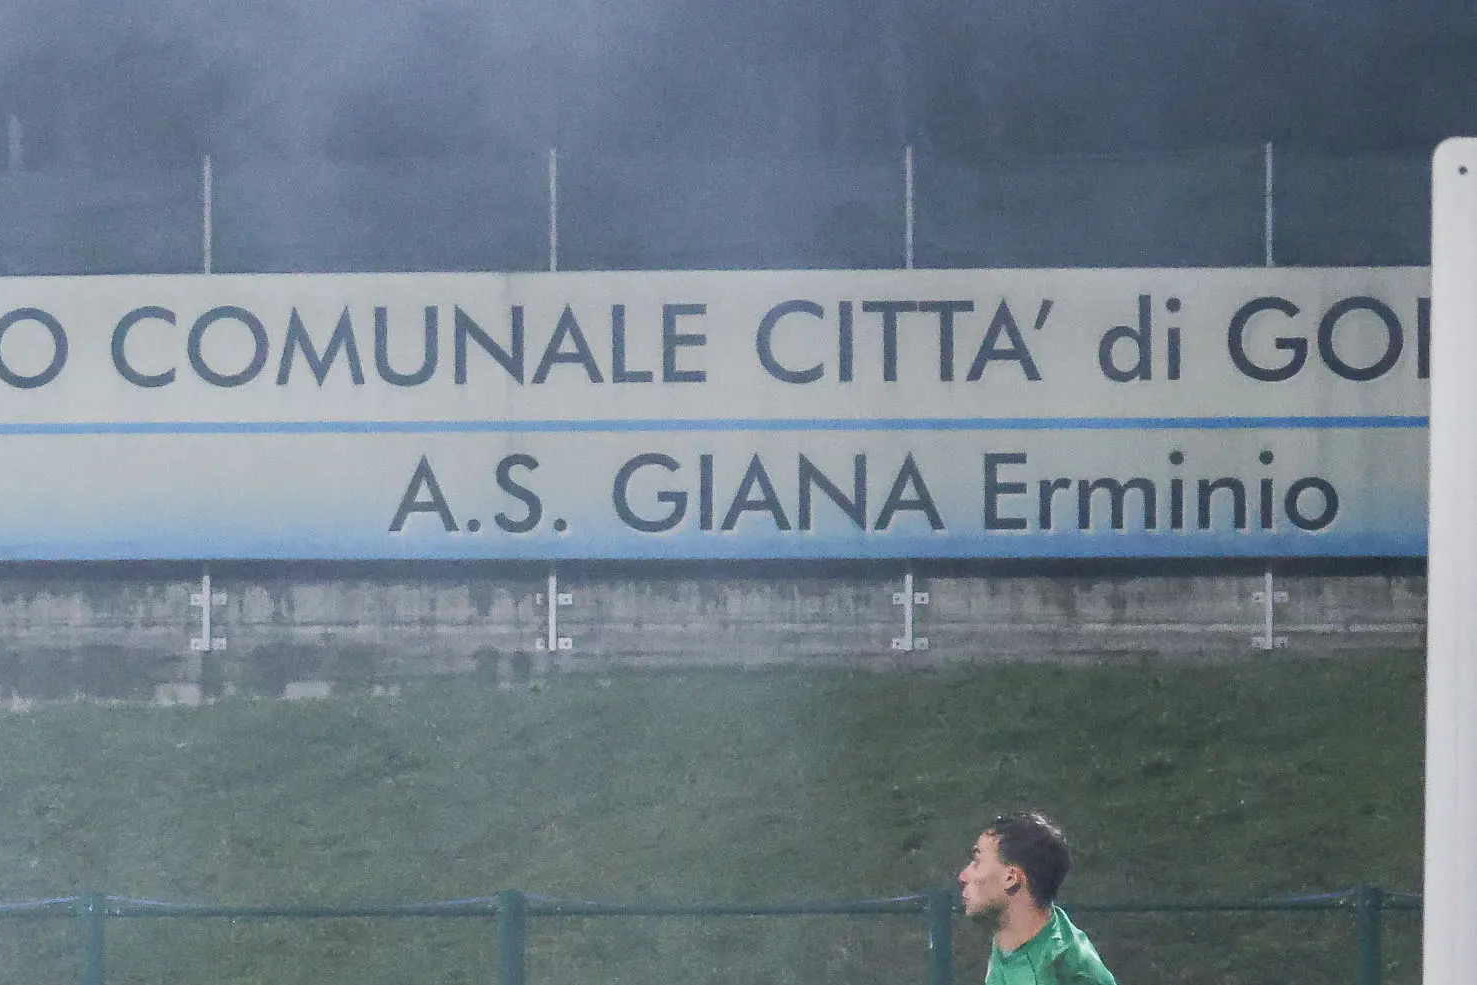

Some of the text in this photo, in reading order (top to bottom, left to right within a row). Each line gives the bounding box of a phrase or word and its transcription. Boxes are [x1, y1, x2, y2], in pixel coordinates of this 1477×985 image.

[110, 304, 707, 389] COMUNALE
[1098, 295, 1182, 383] di
[1227, 296, 1431, 381] GO
[388, 450, 1340, 535] A.S. GIANA Erminio
